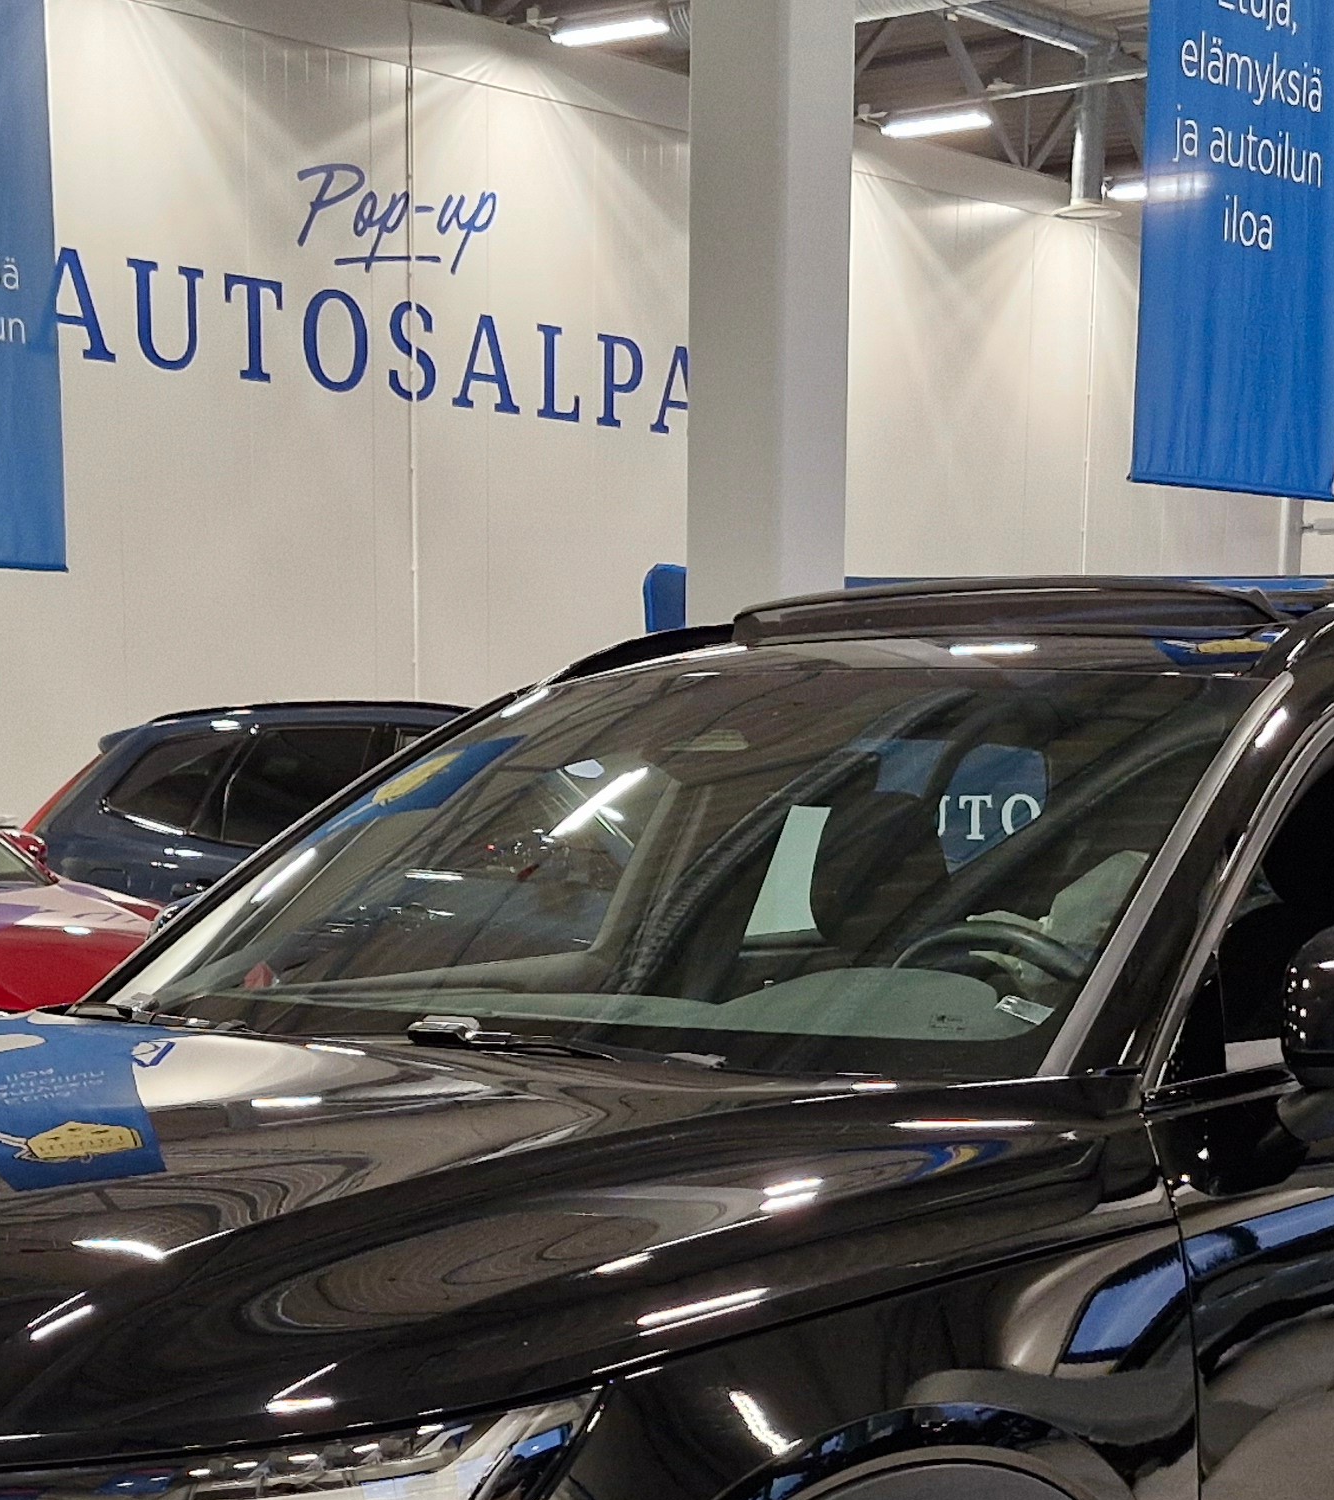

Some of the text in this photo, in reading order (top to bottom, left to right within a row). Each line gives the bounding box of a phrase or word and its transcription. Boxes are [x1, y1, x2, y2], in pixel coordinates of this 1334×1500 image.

[1181, 30, 1323, 113] elämyksiä
[1172, 104, 1322, 188] ja autoilun
[297, 163, 498, 275] Pop-up
[1223, 194, 1273, 251] iloa
